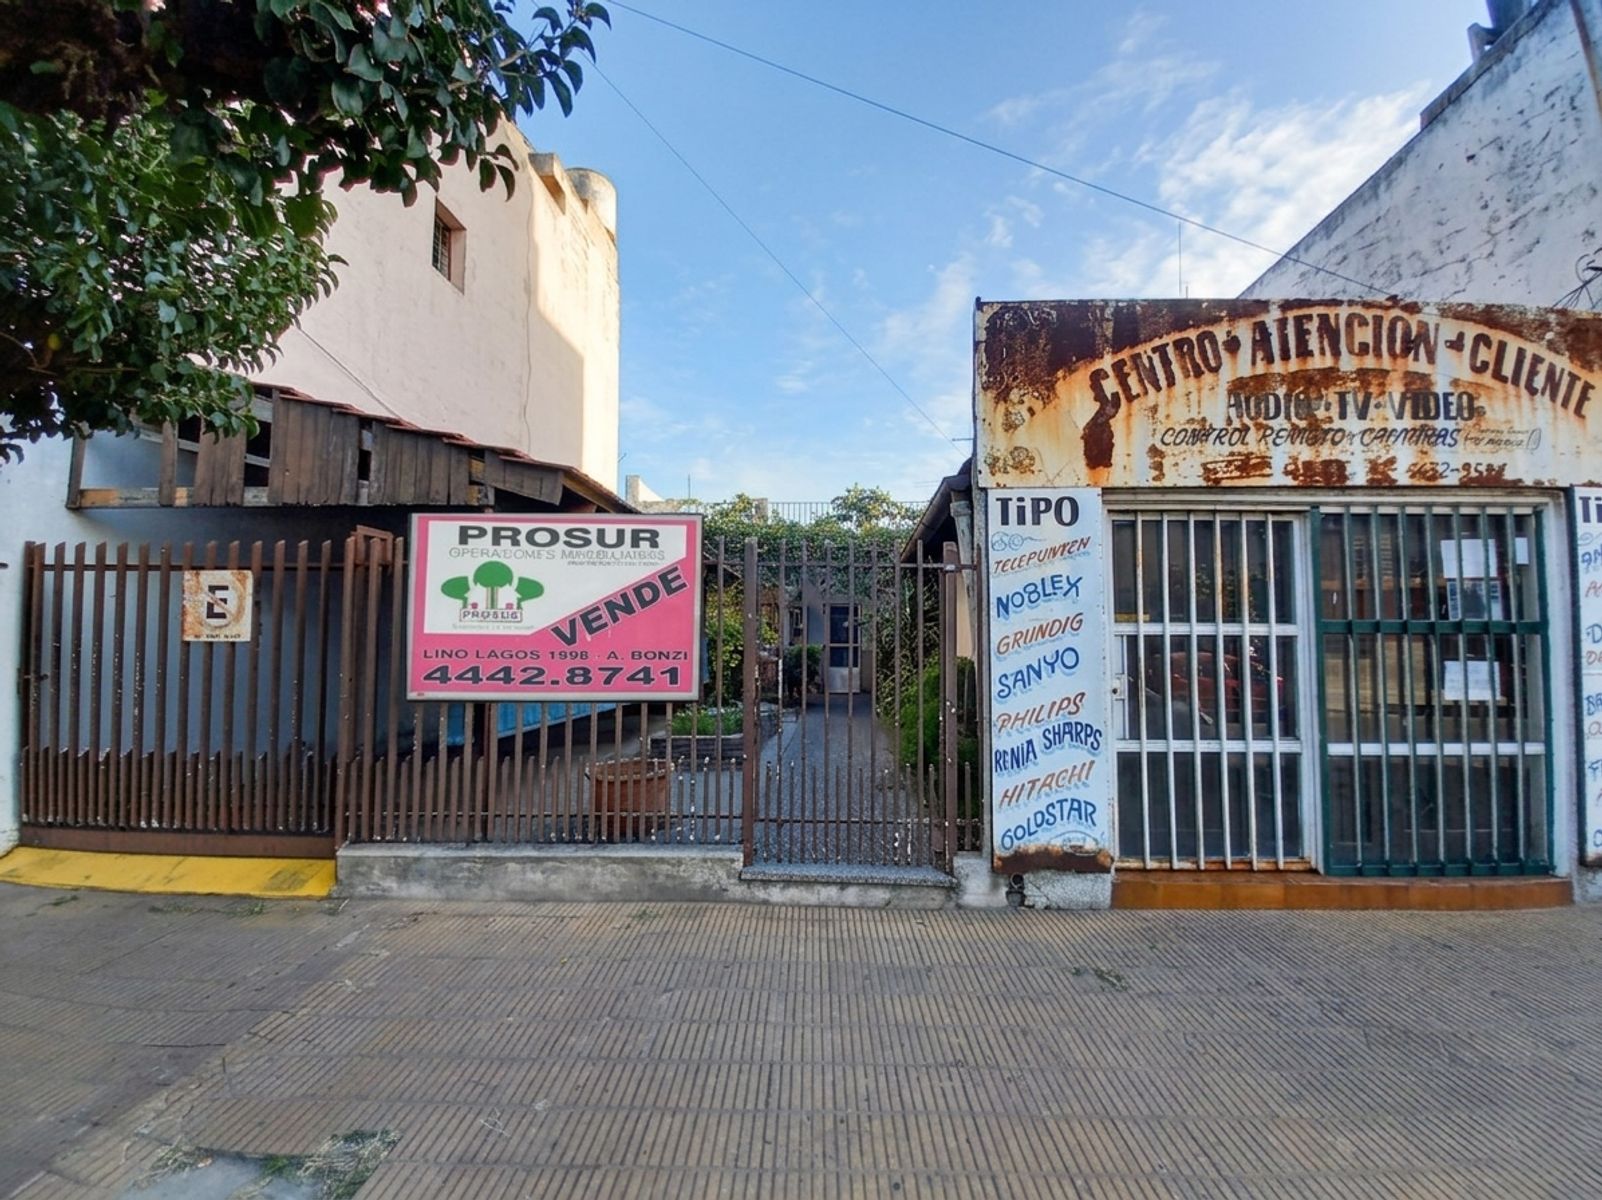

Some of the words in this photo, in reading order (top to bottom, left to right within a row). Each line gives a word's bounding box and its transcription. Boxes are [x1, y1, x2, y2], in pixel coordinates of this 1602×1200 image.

[1089, 330, 1223, 406] CENTRO
[1468, 333, 1596, 419] CLIENTE
[1334, 391, 1372, 421] TV
[1389, 391, 1476, 421] VIDEO
[458, 525, 660, 549] PROSUR
[206, 585, 229, 619] E
[551, 566, 688, 647] VENDE
[997, 612, 1083, 655] GRUNDIG
[423, 650, 469, 660] LINO
[475, 650, 540, 660] LAGOS
[549, 650, 589, 661] 1998
[606, 651, 624, 661] A.
[631, 651, 688, 661] BONZI
[423, 665, 681, 686] 4442.8741
[997, 647, 1080, 698] SANYO
[996, 692, 1086, 734] PHILIPS
[1042, 721, 1102, 751] SHARPS
[1000, 760, 1096, 807] HITACHI
[1001, 798, 1097, 851] GOLDSTAR
